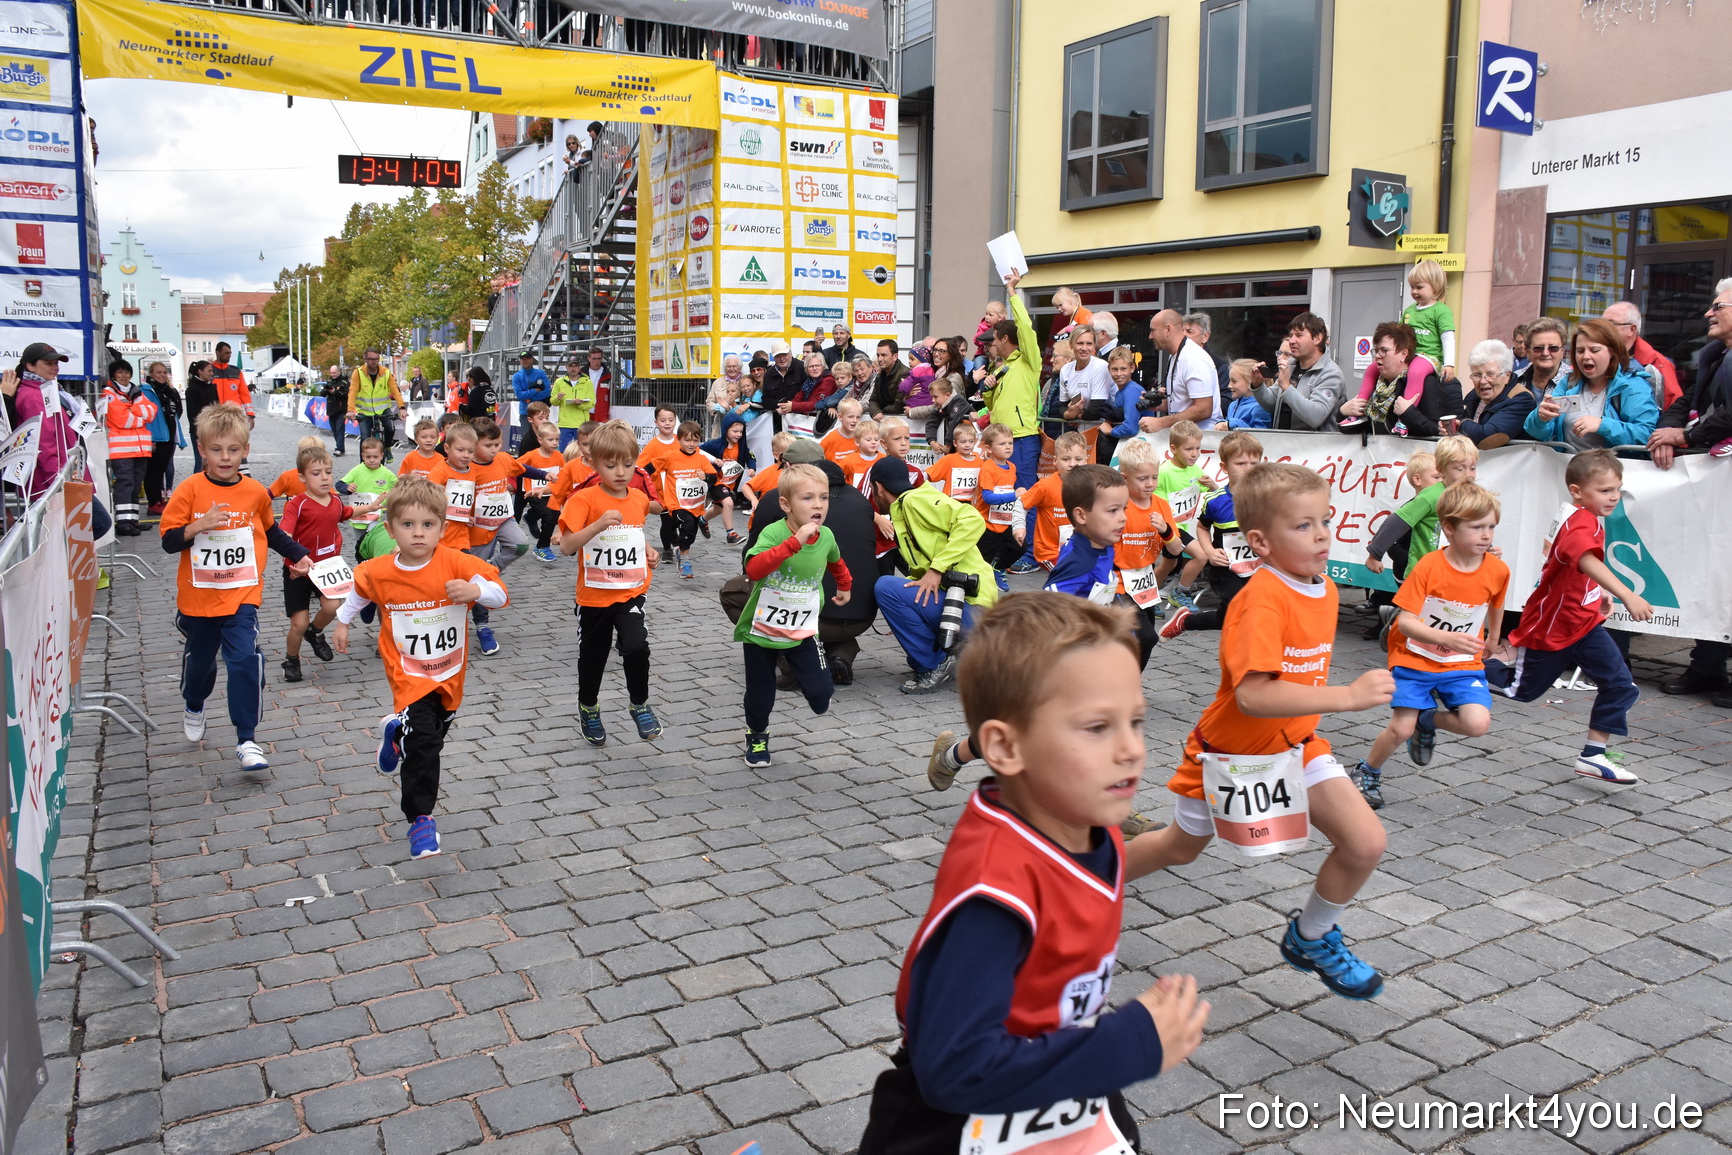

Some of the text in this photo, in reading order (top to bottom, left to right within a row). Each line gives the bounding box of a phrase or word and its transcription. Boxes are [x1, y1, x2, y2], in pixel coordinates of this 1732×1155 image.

[731, 1, 849, 31] www.bockonline.de
[819, 0, 871, 20] LOUNGE
[119, 39, 275, 68] Neumarkter Stadtlauf
[359, 45, 502, 95] ZIEL
[574, 85, 692, 103] Neumarkter Stadtlauf
[752, 105, 777, 116] energie
[0, 117, 70, 145] ÖDL
[28, 143, 70, 154] energie
[790, 140, 825, 154] swn
[1531, 146, 1641, 177] Unterer Markt 15
[821, 183, 840, 192] CODE
[821, 190, 843, 199] CLINIC
[740, 224, 781, 235] VARIOTEC
[1405, 236, 1447, 245] Startnummern-
[1413, 243, 1438, 251] ausgabe
[17, 245, 44, 257] Braun
[822, 278, 847, 287] energie
[874, 272, 888, 280] MINI
[13, 299, 57, 309] Neumarkter
[5, 307, 65, 318] Lammsbräu
[131, 345, 167, 354] Laufsport
[956, 477, 978, 488] 7133
[681, 486, 704, 498] 7254
[1175, 494, 1197, 513] 7111
[482, 504, 509, 517] 7284
[200, 546, 245, 566] 7169
[592, 547, 638, 566] 7194
[214, 572, 234, 580] Moritz
[318, 567, 352, 587] 7018
[1131, 572, 1155, 592] 7030
[334, 585, 350, 594] Tobias
[780, 583, 815, 593] BOCK
[421, 613, 448, 624] BOCK
[765, 605, 813, 627] 7317
[405, 626, 457, 656] 7149
[1281, 657, 1326, 673] Stadtlauf
[1241, 762, 1274, 775] BOCK
[1218, 778, 1291, 816] 7104
[1248, 826, 1270, 839] Tom
